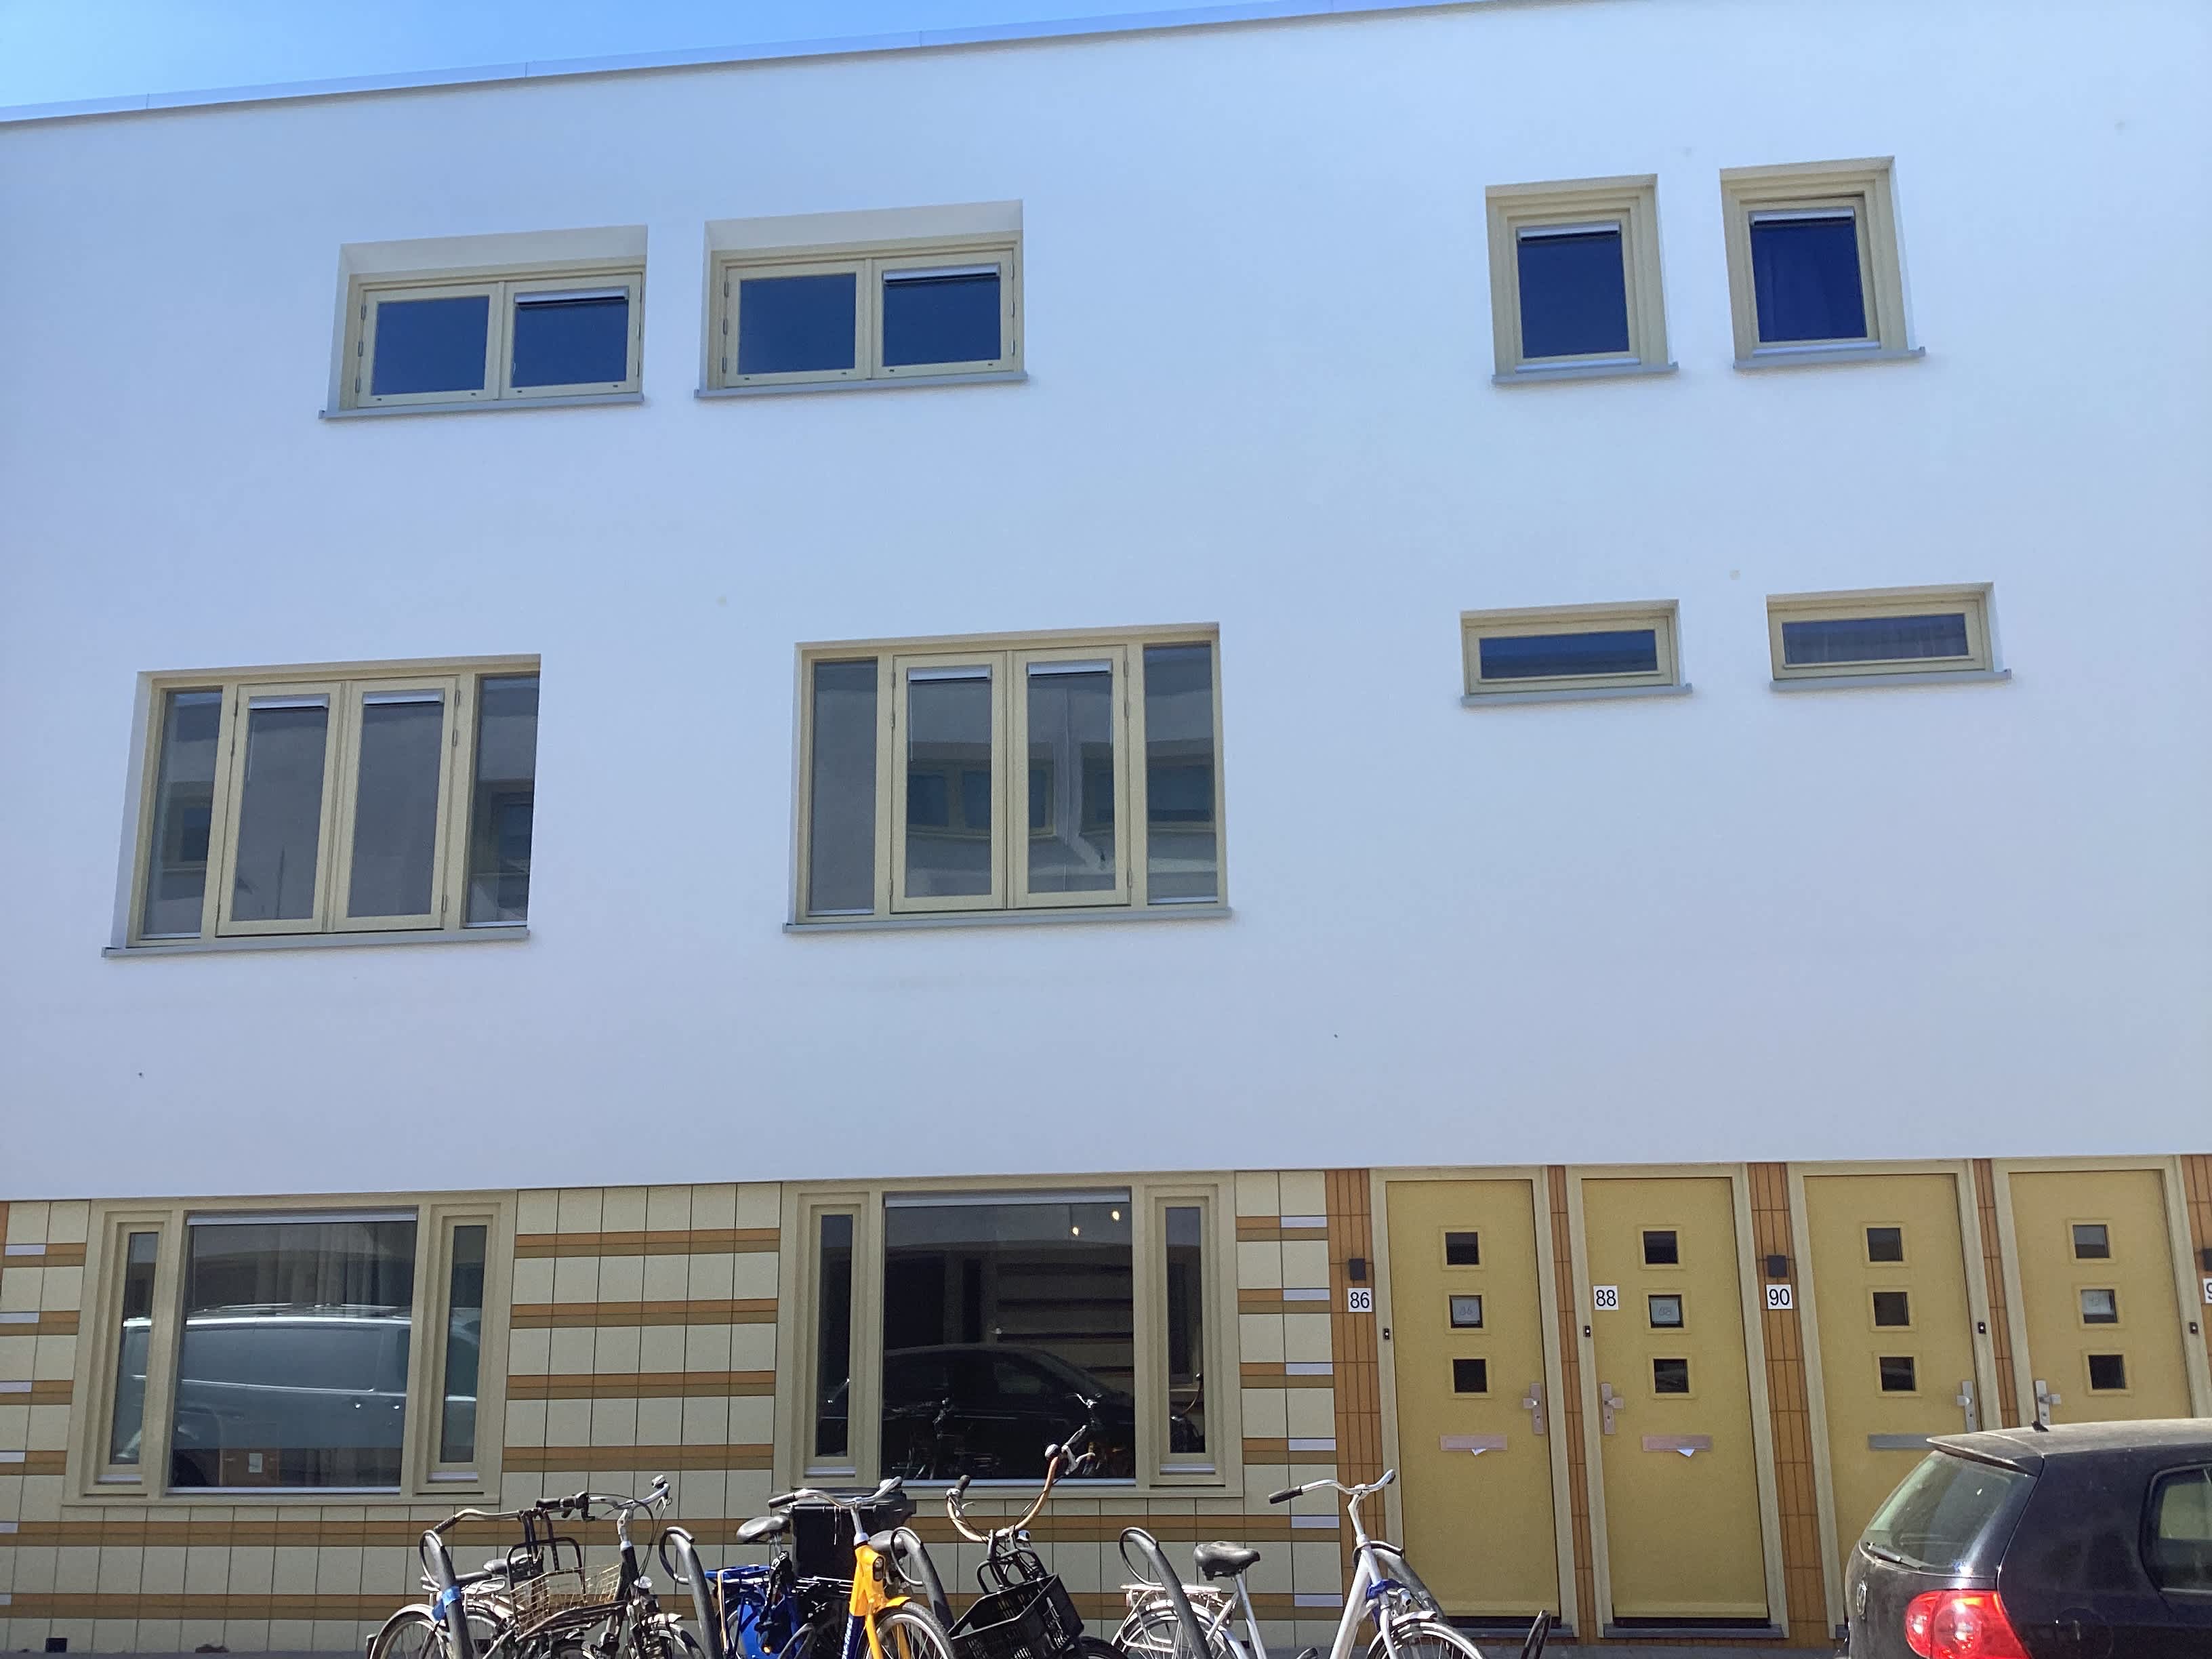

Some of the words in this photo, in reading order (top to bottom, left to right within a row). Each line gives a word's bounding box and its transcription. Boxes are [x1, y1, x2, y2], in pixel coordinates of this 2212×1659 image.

[1350, 1291, 1370, 1309] 86
[1596, 1289, 1616, 1307] 88
[1769, 1288, 1790, 1306] 90
